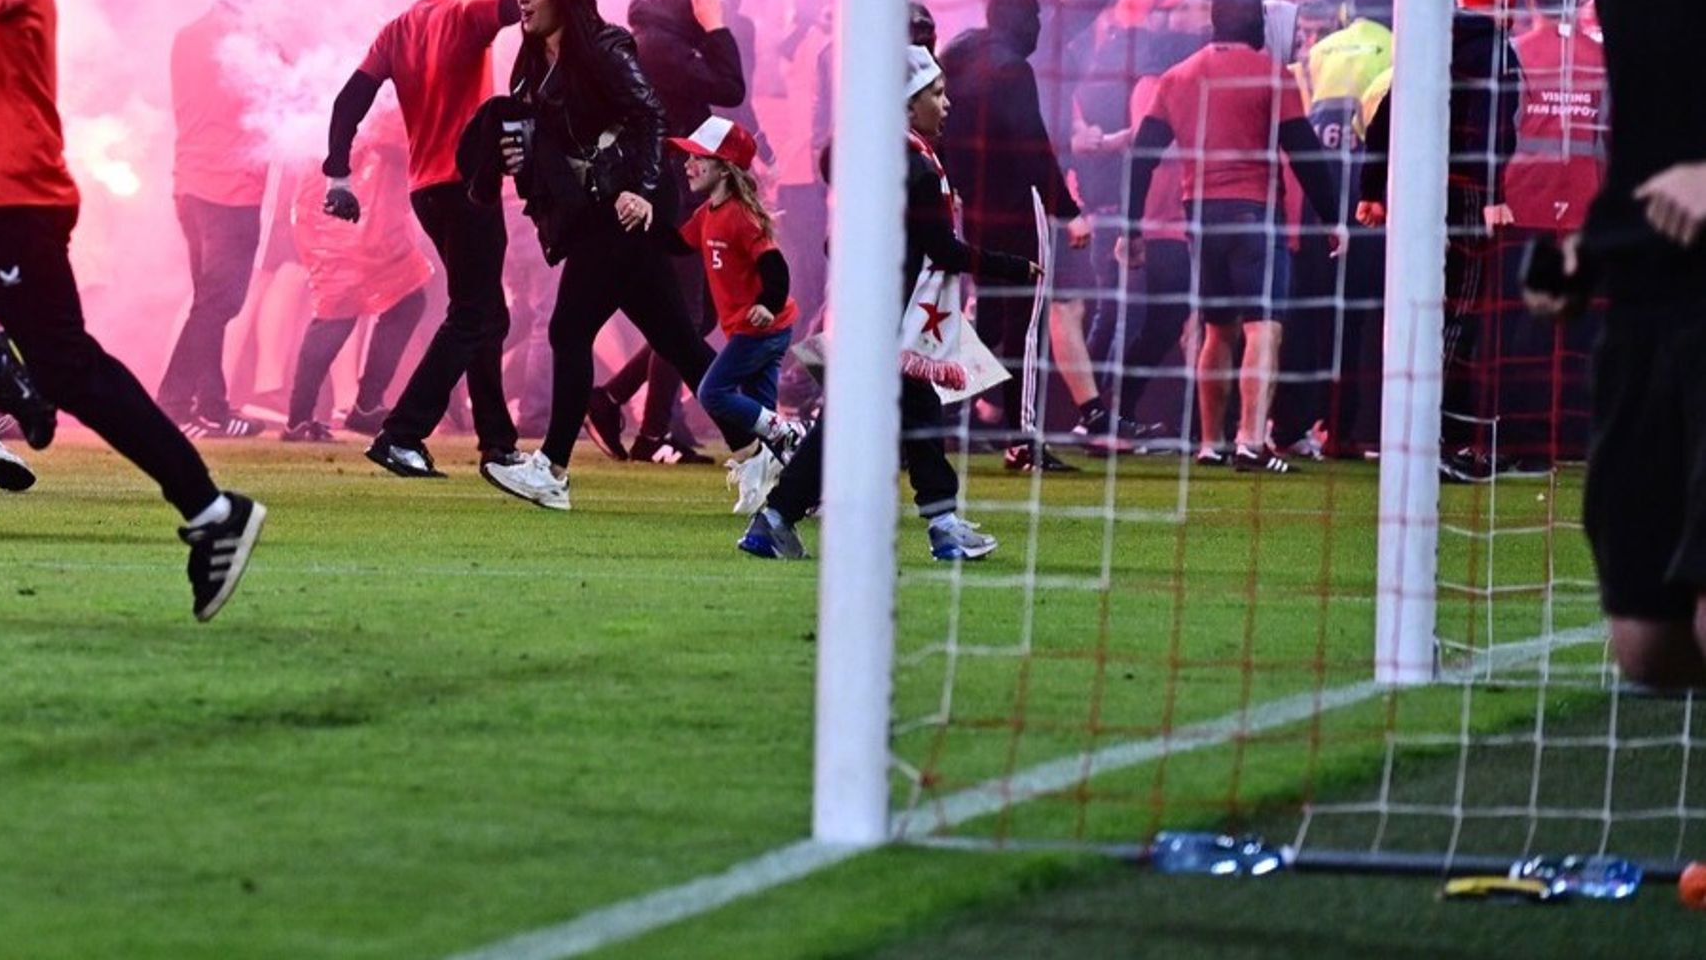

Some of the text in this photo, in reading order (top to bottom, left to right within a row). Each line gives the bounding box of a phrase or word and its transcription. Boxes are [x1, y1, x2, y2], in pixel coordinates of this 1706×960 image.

[1541, 90, 1591, 103] VISITING
[1527, 104, 1599, 117] FAN SUPPOT
[1554, 201, 1569, 221] 7
[712, 249, 723, 269] 5
